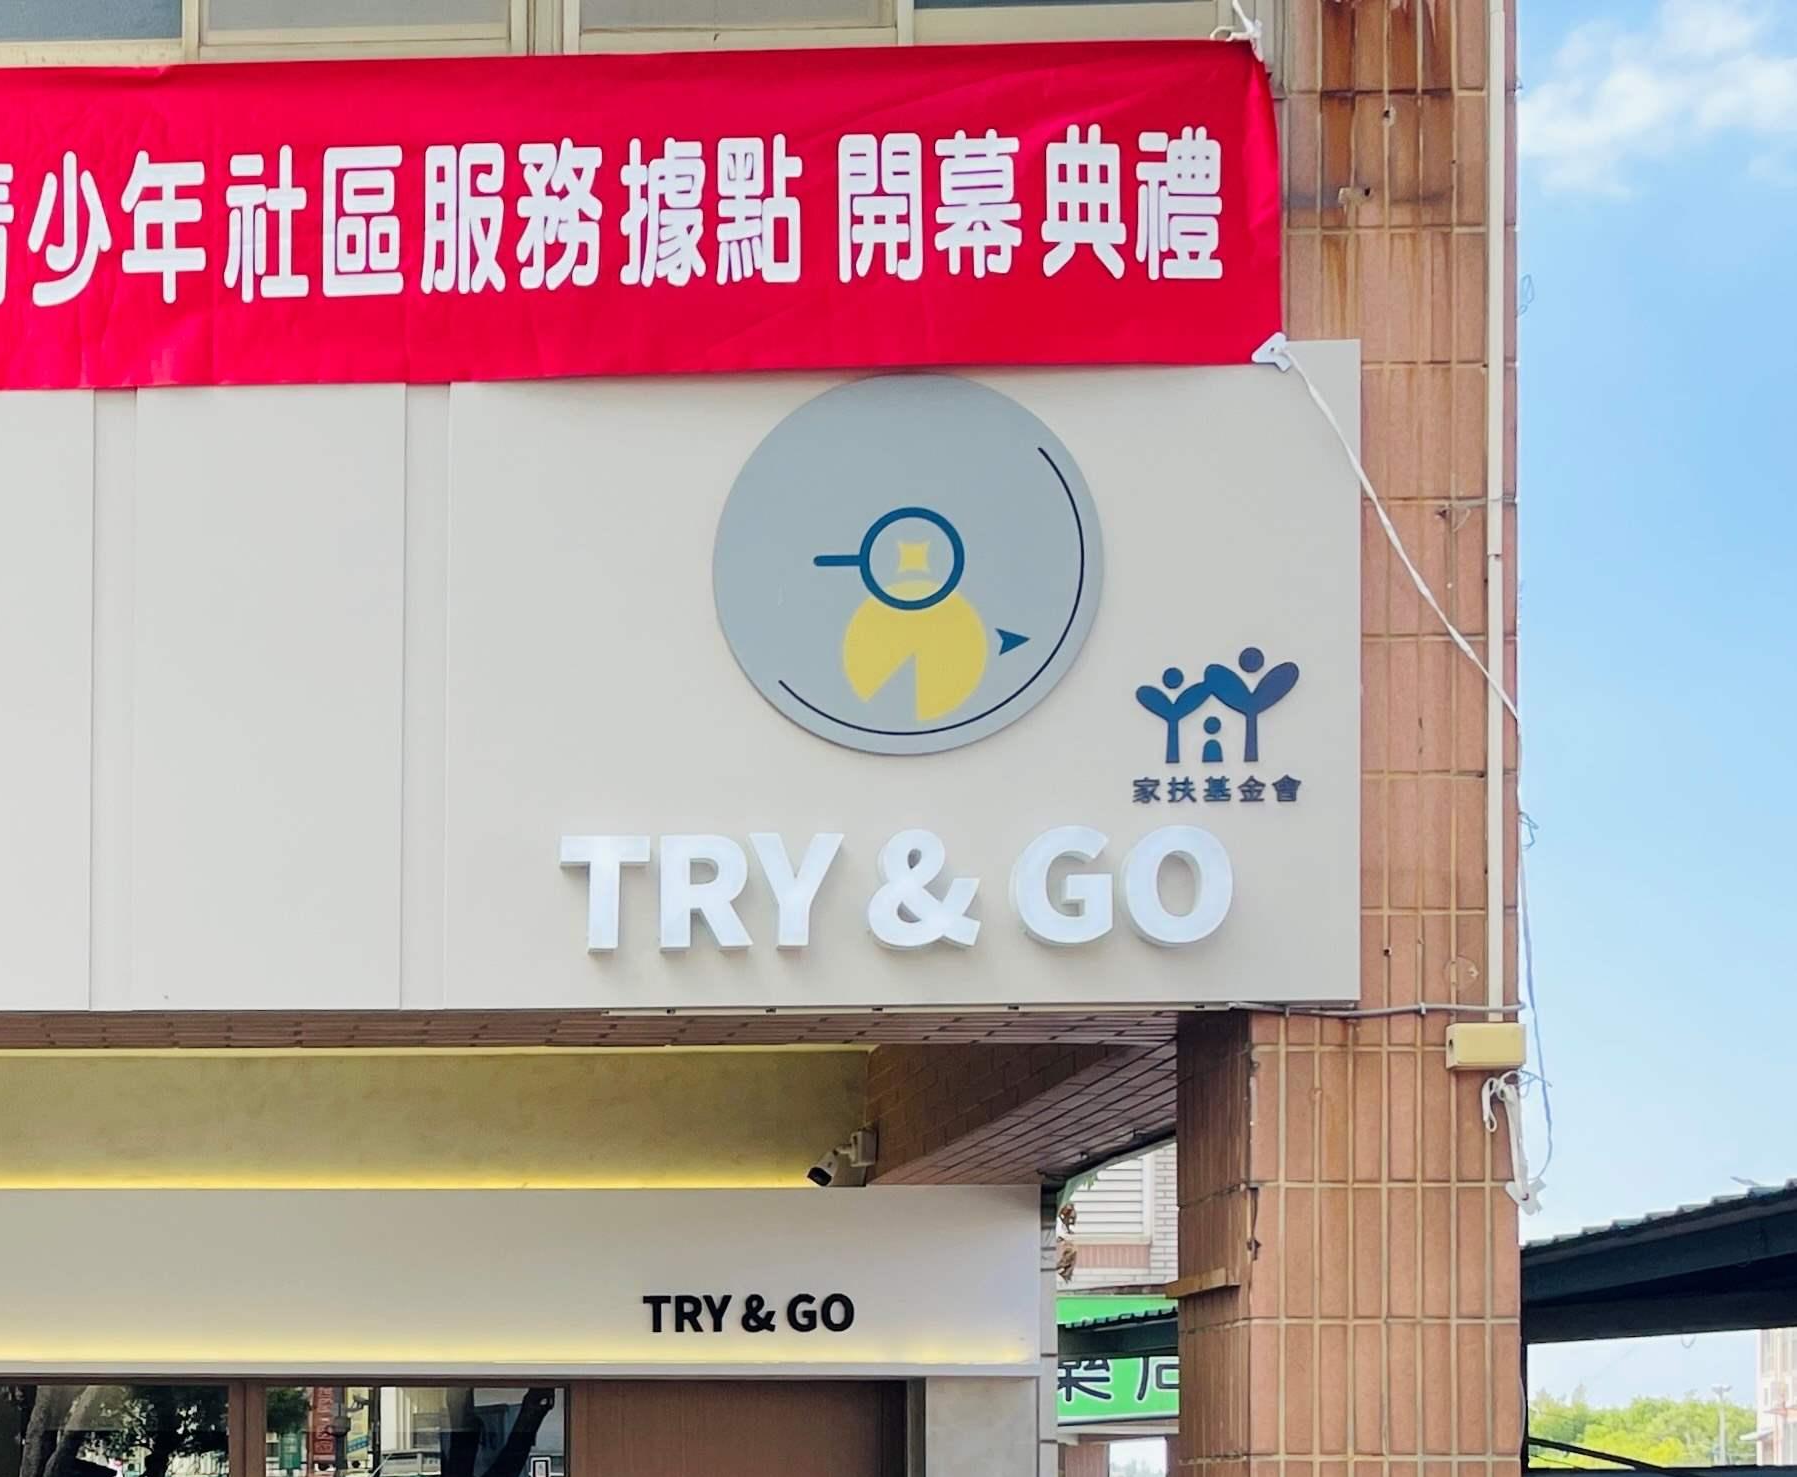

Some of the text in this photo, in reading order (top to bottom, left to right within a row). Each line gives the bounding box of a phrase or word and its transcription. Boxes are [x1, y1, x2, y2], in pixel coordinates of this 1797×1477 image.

[838, 124, 1223, 283] 開幕典禮
[1131, 774, 1302, 803] 家扶基金會
[559, 825, 1233, 952] TRY & GO
[643, 1294, 855, 1333] TRY & GO
